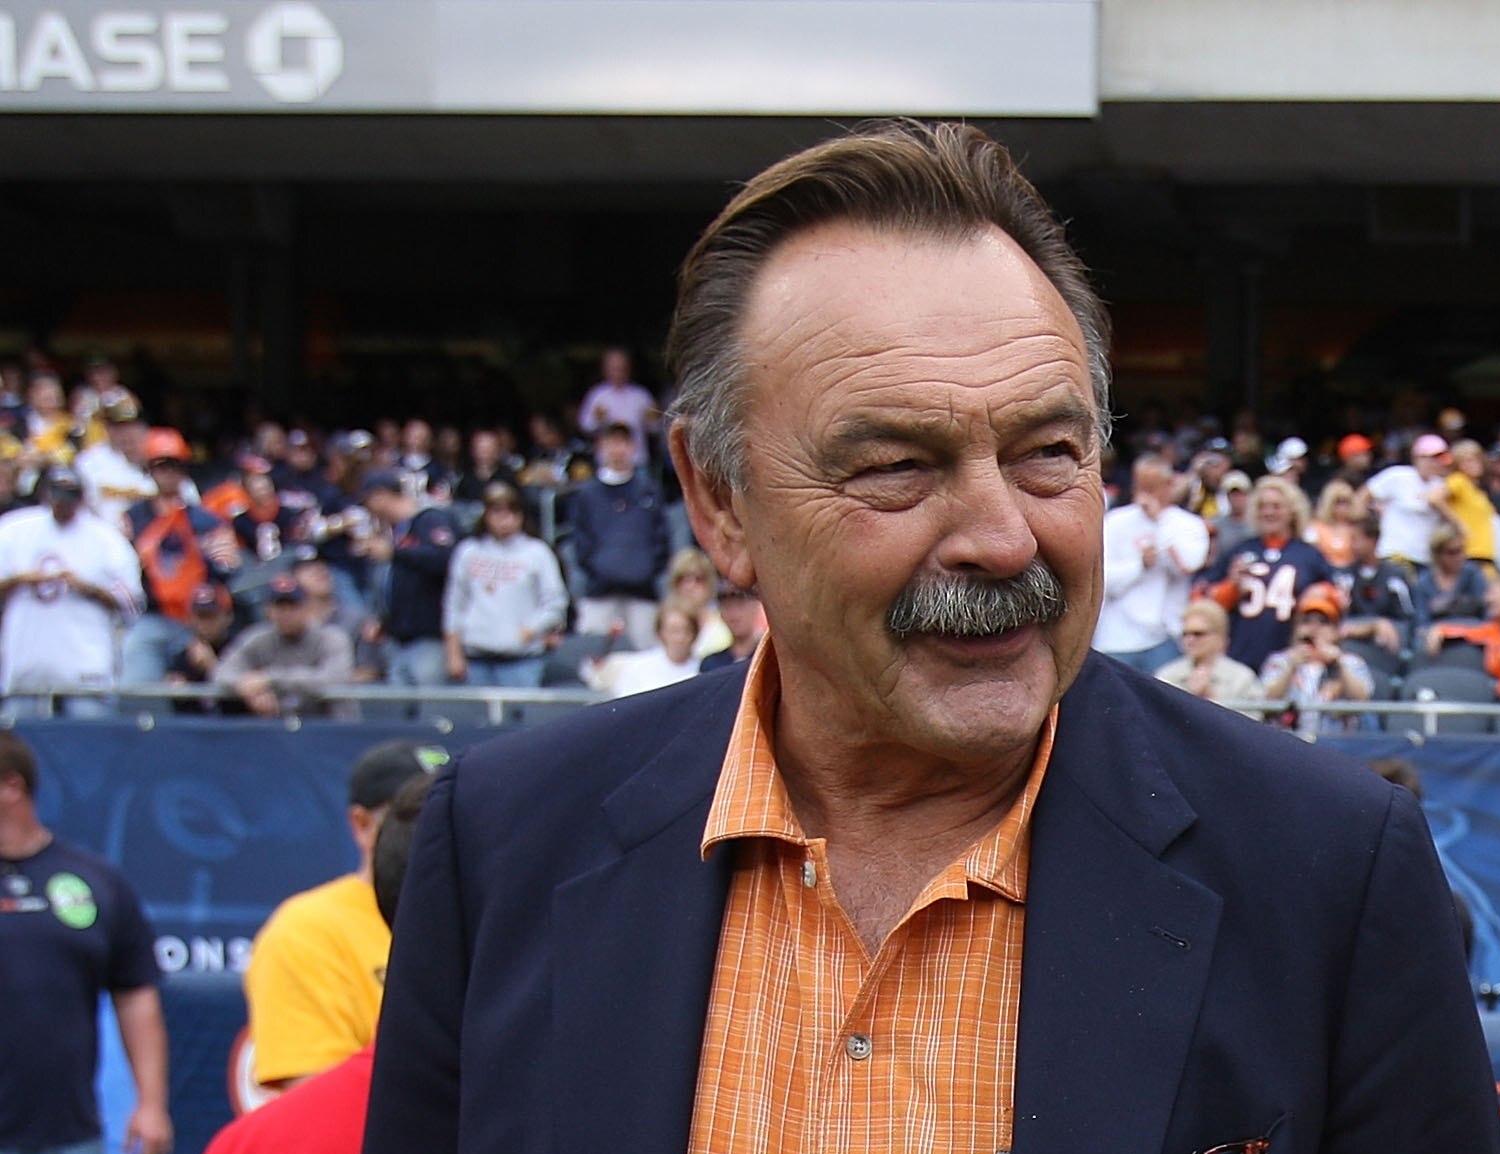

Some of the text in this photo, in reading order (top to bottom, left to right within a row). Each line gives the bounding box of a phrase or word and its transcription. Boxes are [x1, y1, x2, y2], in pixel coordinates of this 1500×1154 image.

[0, 10, 231, 92] ASE
[1239, 562, 1297, 622] 54
[154, 936, 253, 973] ONS
